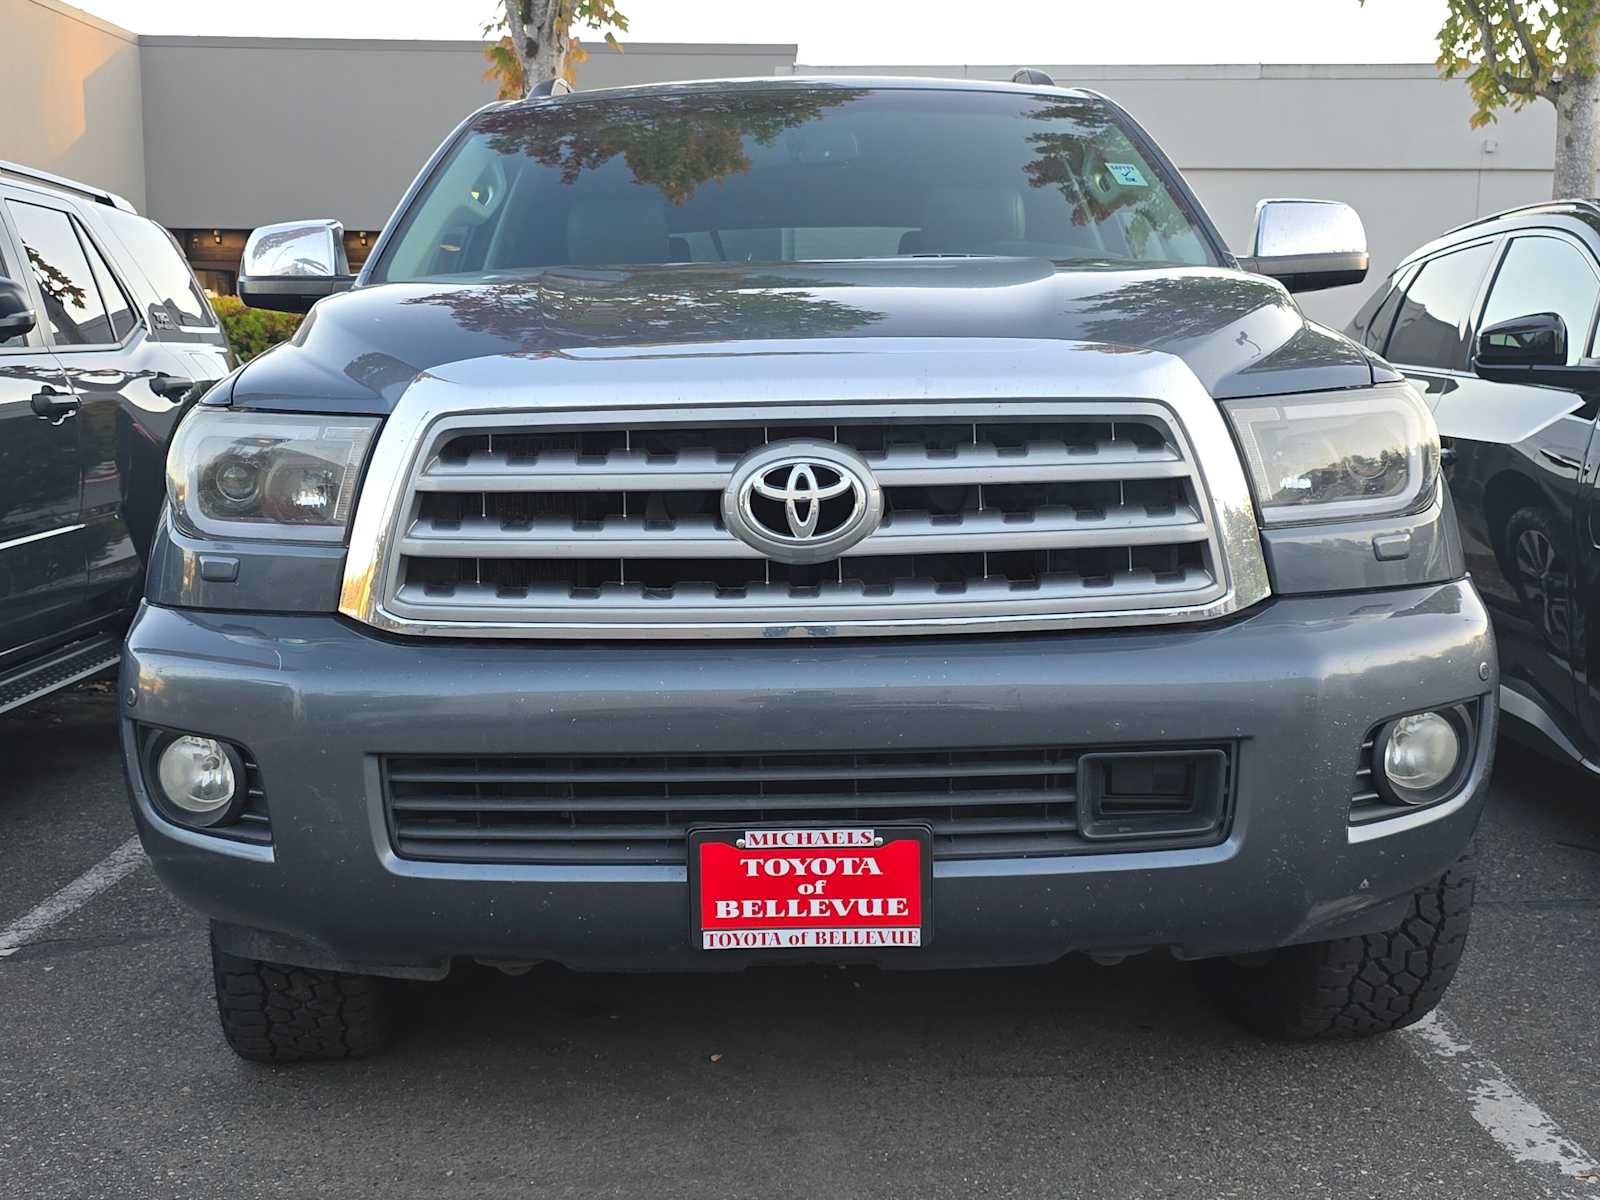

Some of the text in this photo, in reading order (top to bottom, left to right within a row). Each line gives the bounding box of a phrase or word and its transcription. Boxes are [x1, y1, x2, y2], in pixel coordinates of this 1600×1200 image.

[749, 831, 873, 846] MICHAELS
[740, 857, 883, 877] TOYOTA
[797, 879, 827, 895] of
[715, 897, 909, 918] BELLEVUE
[704, 929, 918, 947] TOYOTA of BELLEVUE
